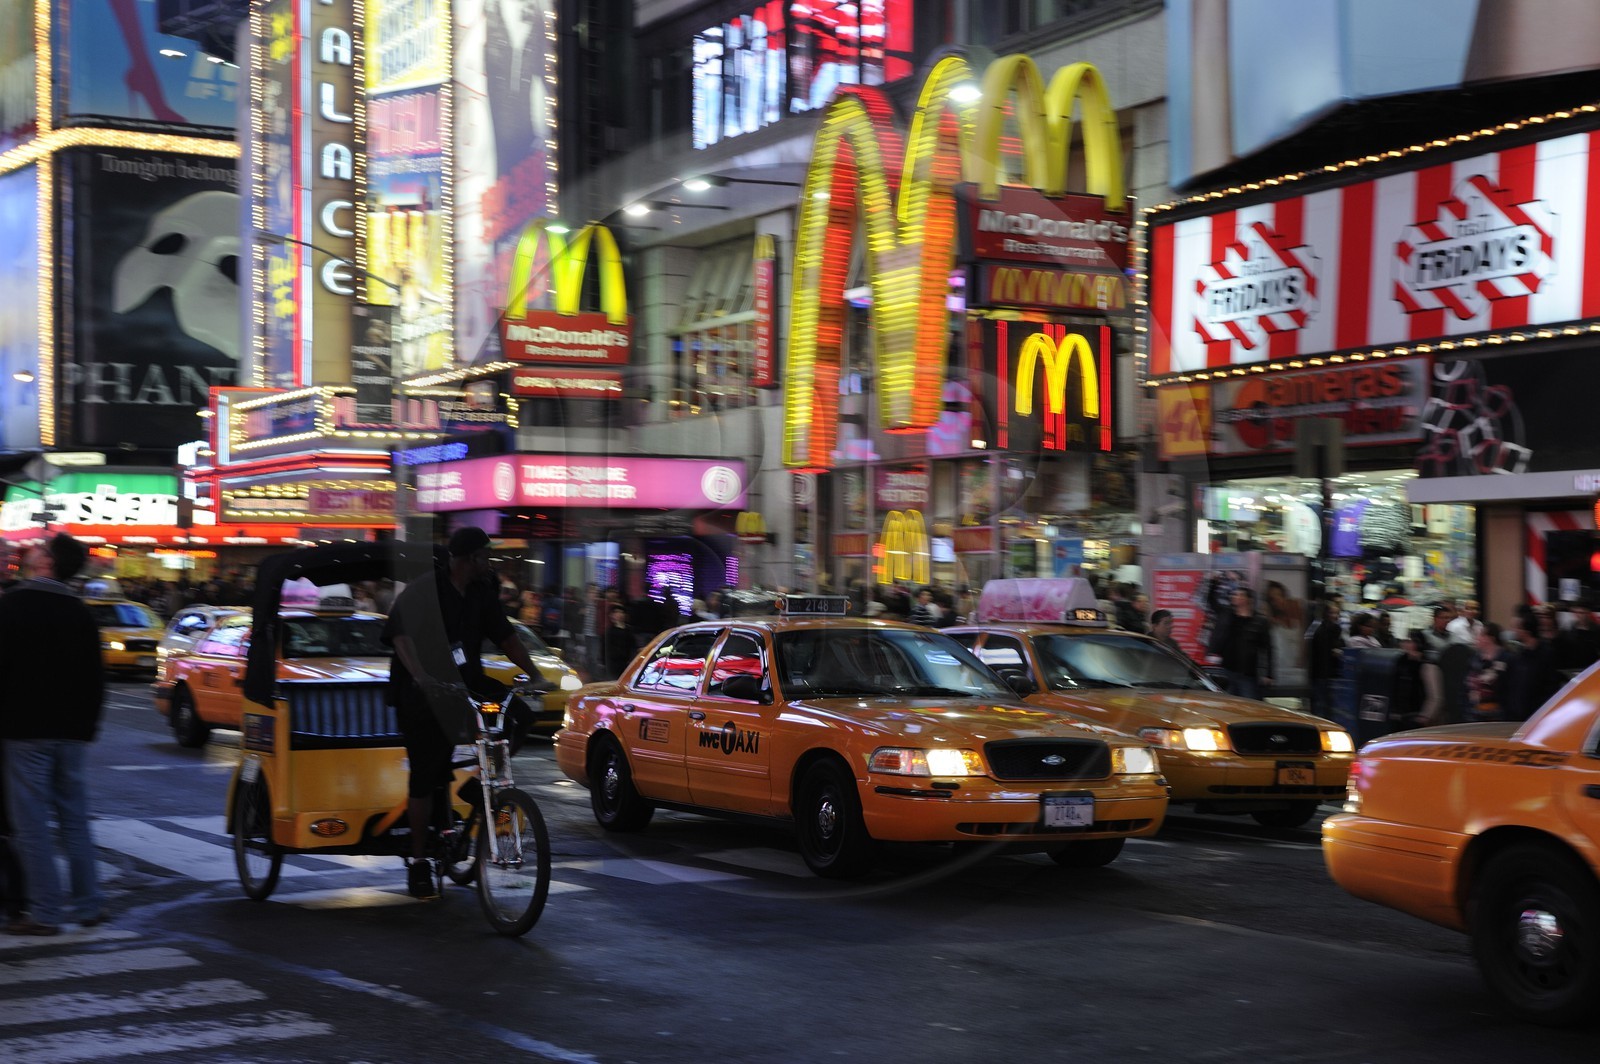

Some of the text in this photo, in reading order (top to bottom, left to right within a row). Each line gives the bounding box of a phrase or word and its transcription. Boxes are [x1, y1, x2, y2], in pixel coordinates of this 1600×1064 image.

[320, 0, 354, 296] ALACE
[977, 209, 1128, 244] McDonald's
[506, 325, 629, 347] McDonald's
[521, 465, 628, 482] TIMES SQUARE
[579, 484, 637, 499] CENTER
[805, 599, 829, 612] 2T48
[699, 731, 720, 749] NYC
[720, 720, 760, 755] TAXI
